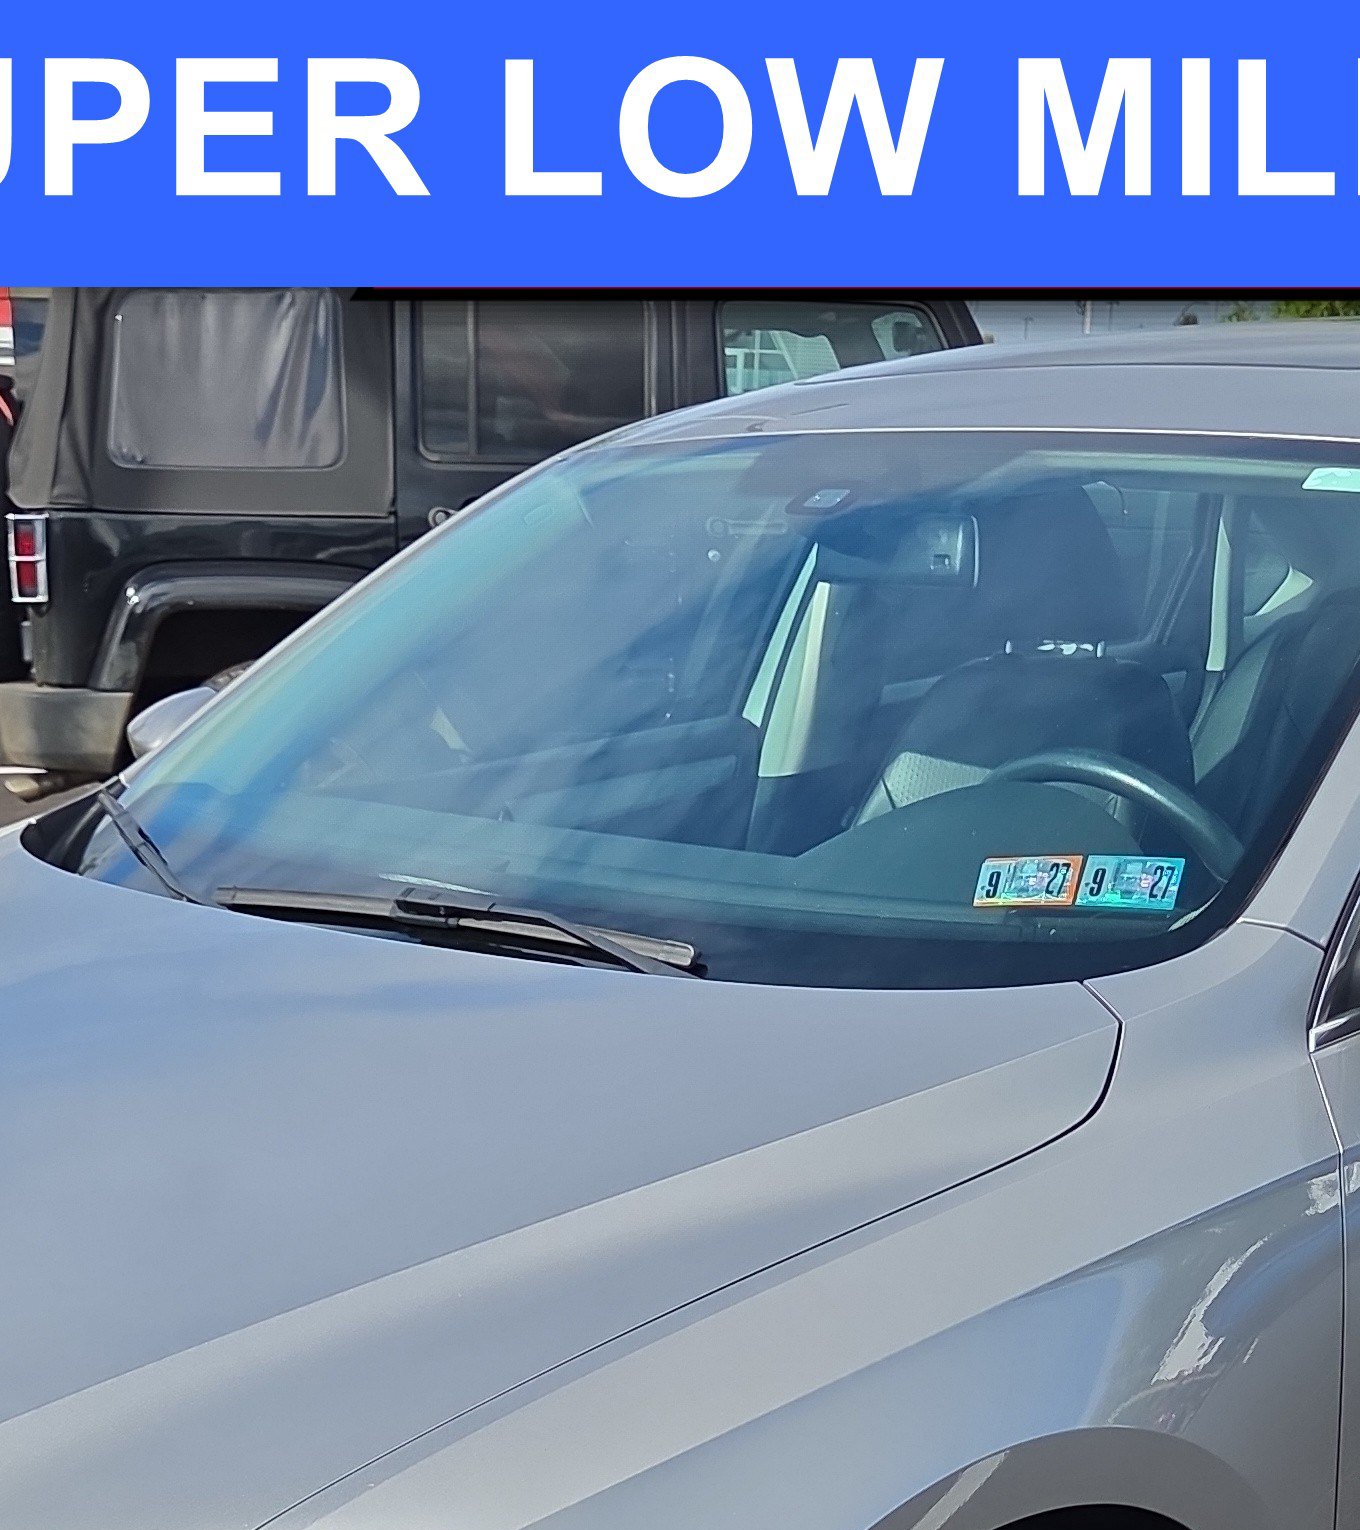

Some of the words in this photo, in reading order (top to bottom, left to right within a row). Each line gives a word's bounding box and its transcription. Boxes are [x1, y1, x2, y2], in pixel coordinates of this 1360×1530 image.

[985, 871, 1001, 898] 9
[1044, 863, 1071, 898] 27
[1090, 867, 1107, 897] 9
[1148, 865, 1176, 899] 27
